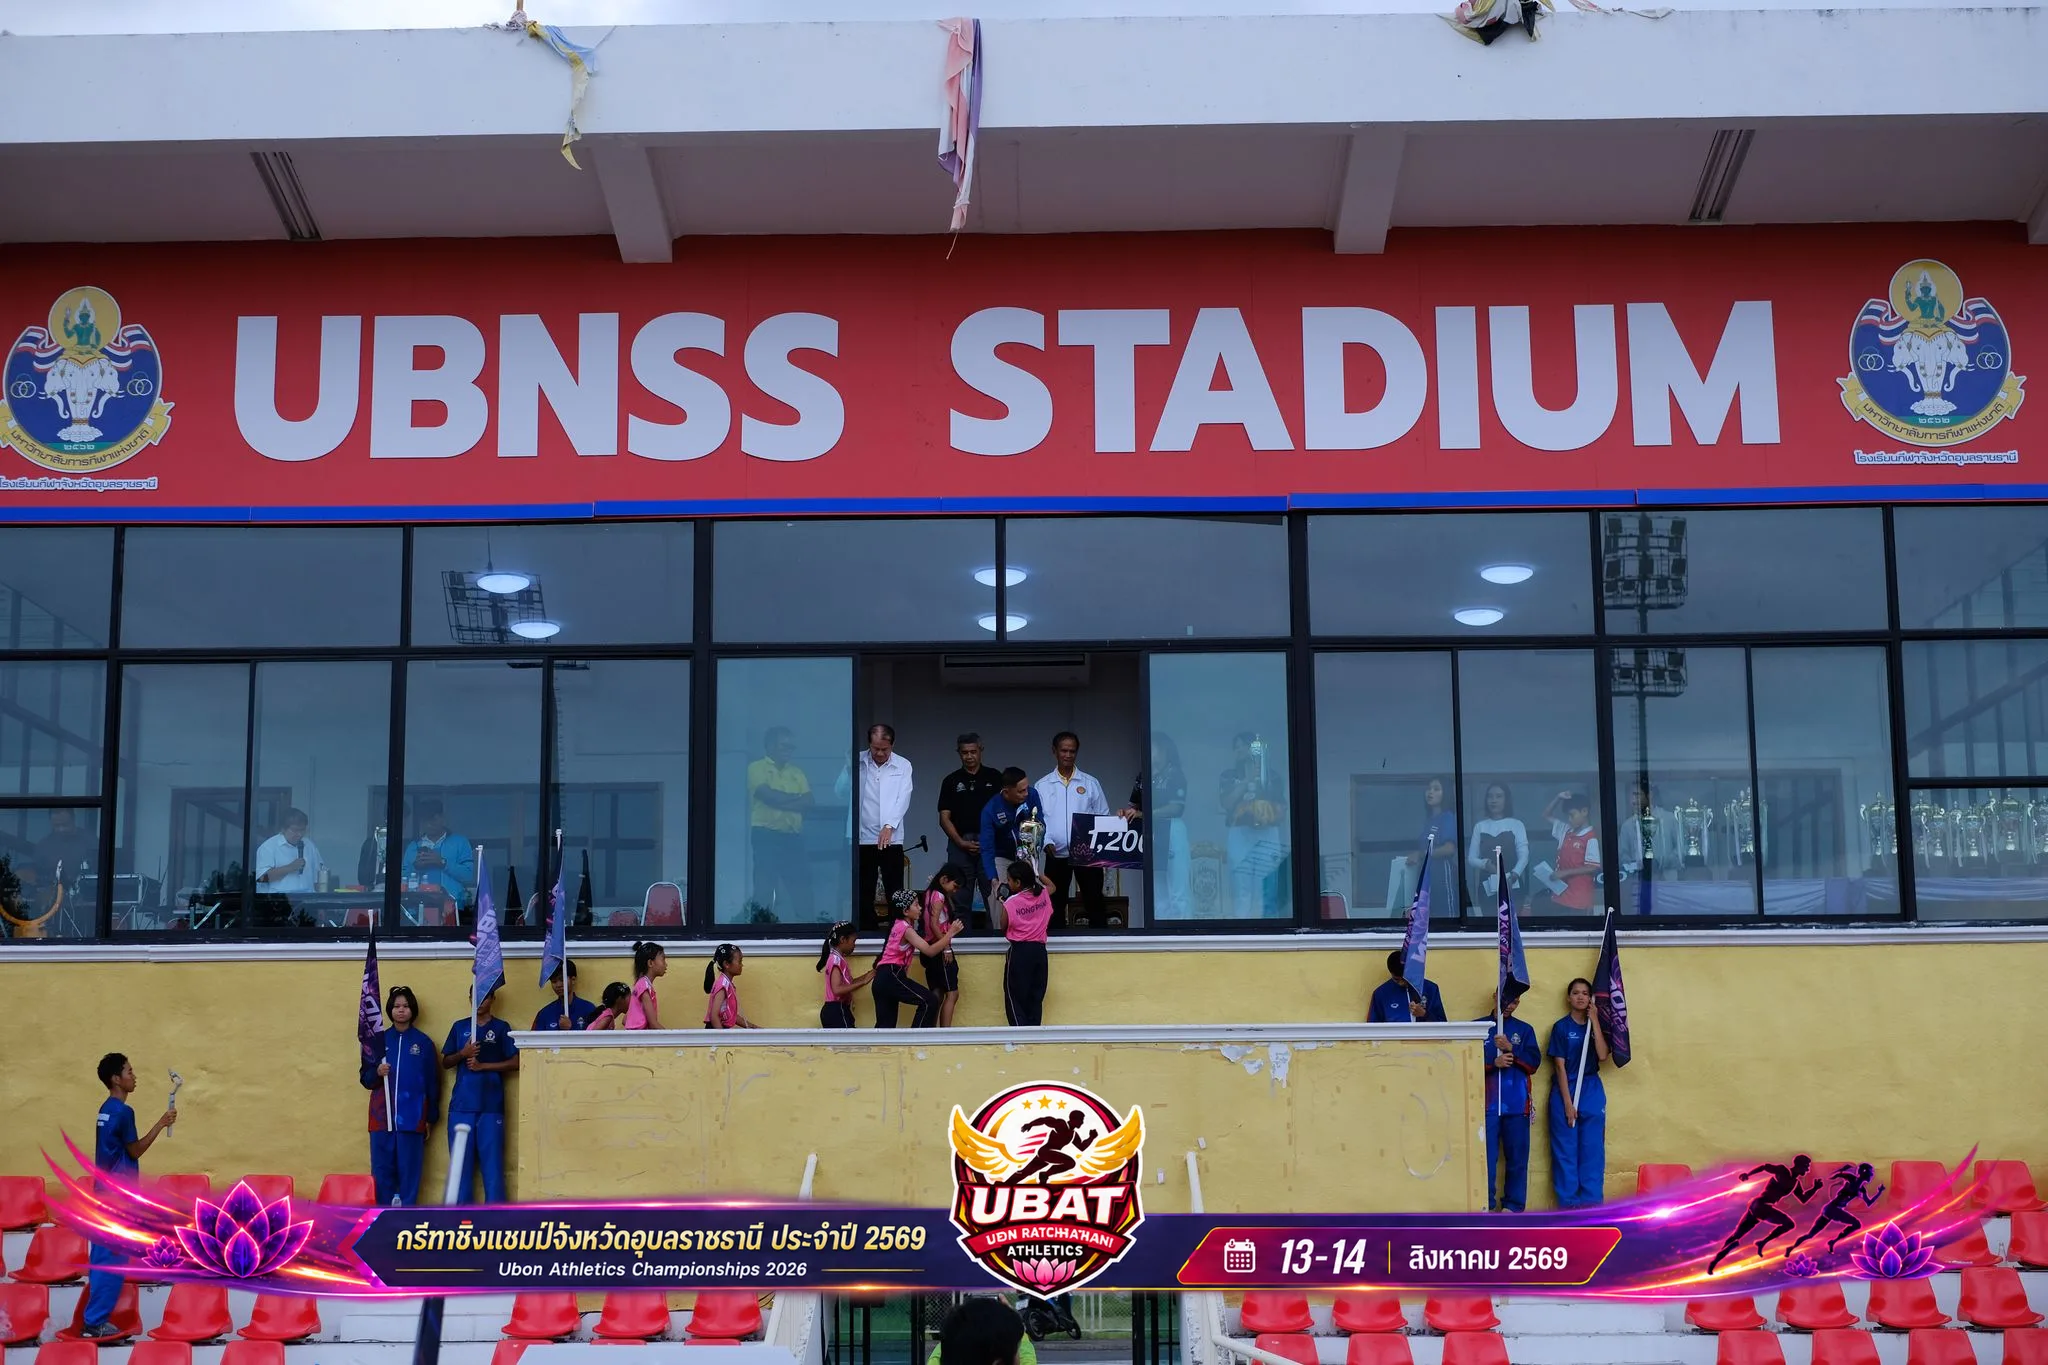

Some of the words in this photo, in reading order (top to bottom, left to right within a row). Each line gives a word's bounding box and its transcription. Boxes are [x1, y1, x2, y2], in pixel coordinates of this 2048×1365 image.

[235, 312, 845, 462] UBNSS
[948, 300, 1781, 455] STADIUM
[1862, 402, 2005, 440] มหาวิทยาลัยการกีฬาแห่งชาติ
[1855, 451, 2017, 465] โรงเรียนกีฬาจังหวัดอุบลราชธานี
